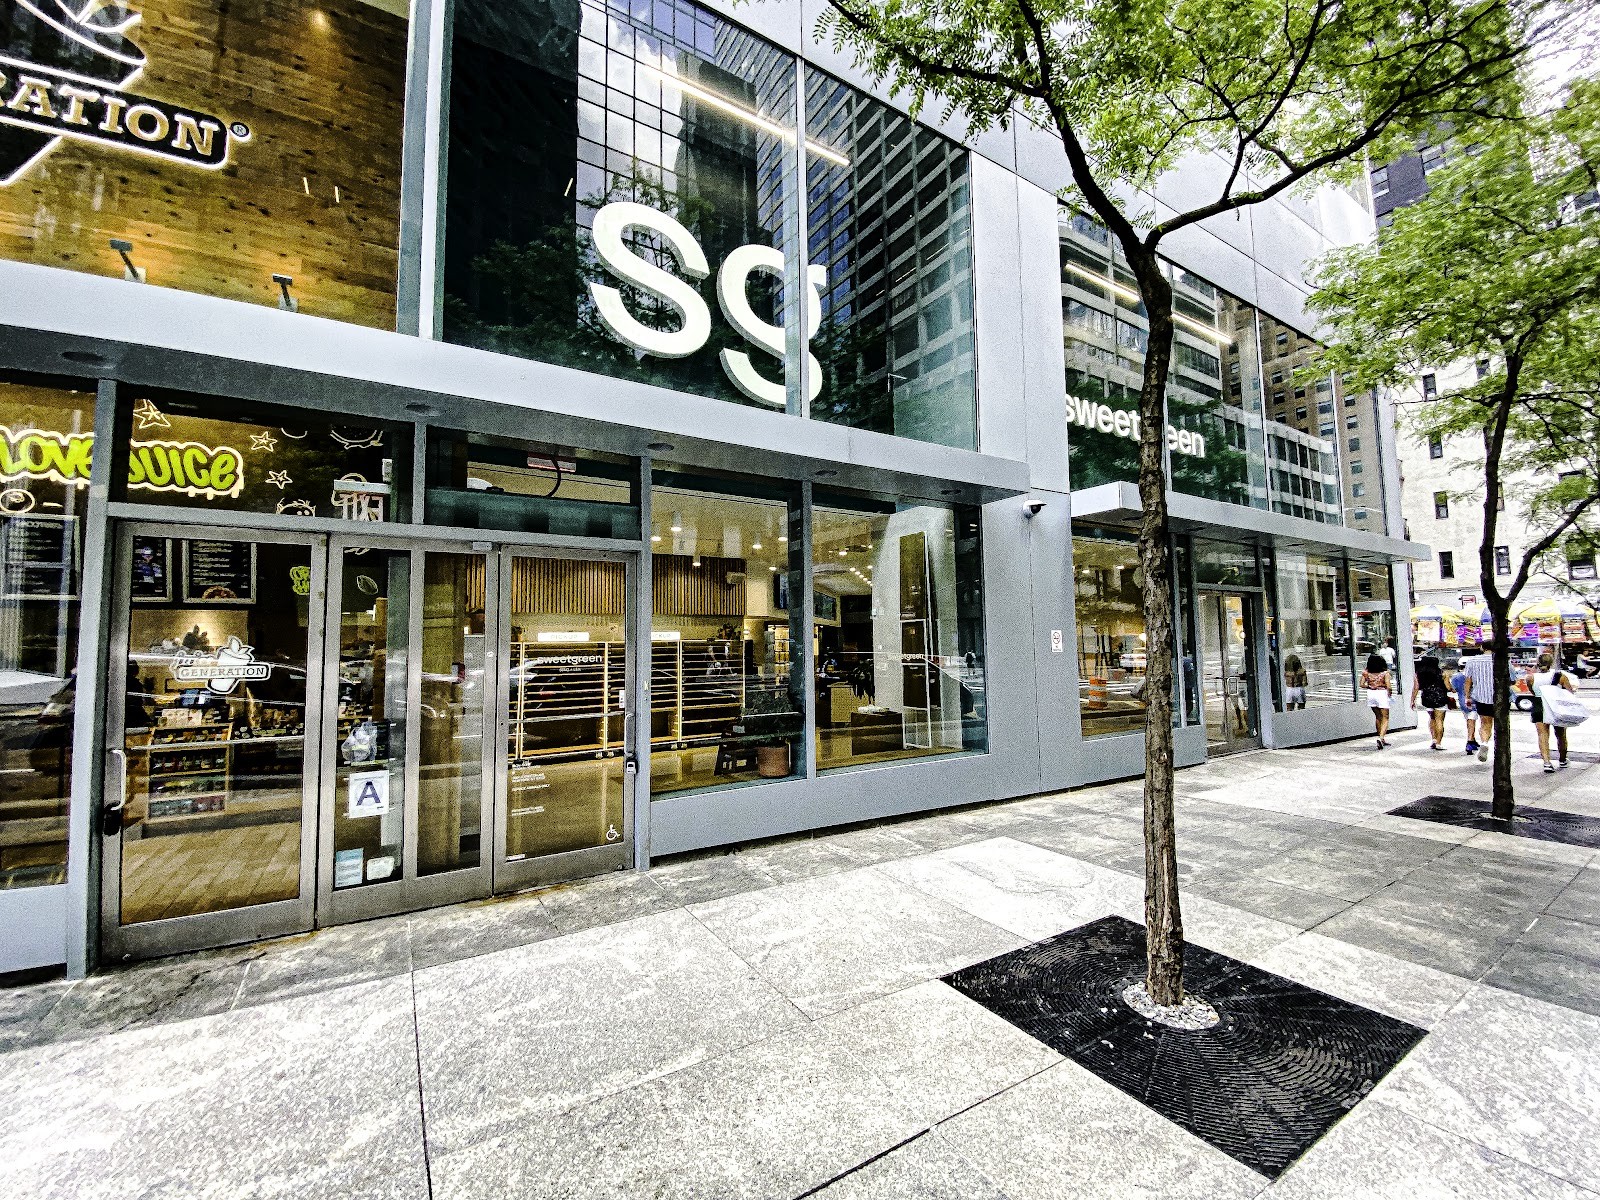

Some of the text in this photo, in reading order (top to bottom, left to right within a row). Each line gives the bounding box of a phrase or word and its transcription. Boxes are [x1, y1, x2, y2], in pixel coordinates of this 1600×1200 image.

[1066, 393, 1206, 458] sweeteen
[537, 655, 603, 665] sweetgreen
[181, 667, 266, 677] GENERATION
[356, 781, 382, 807] A
